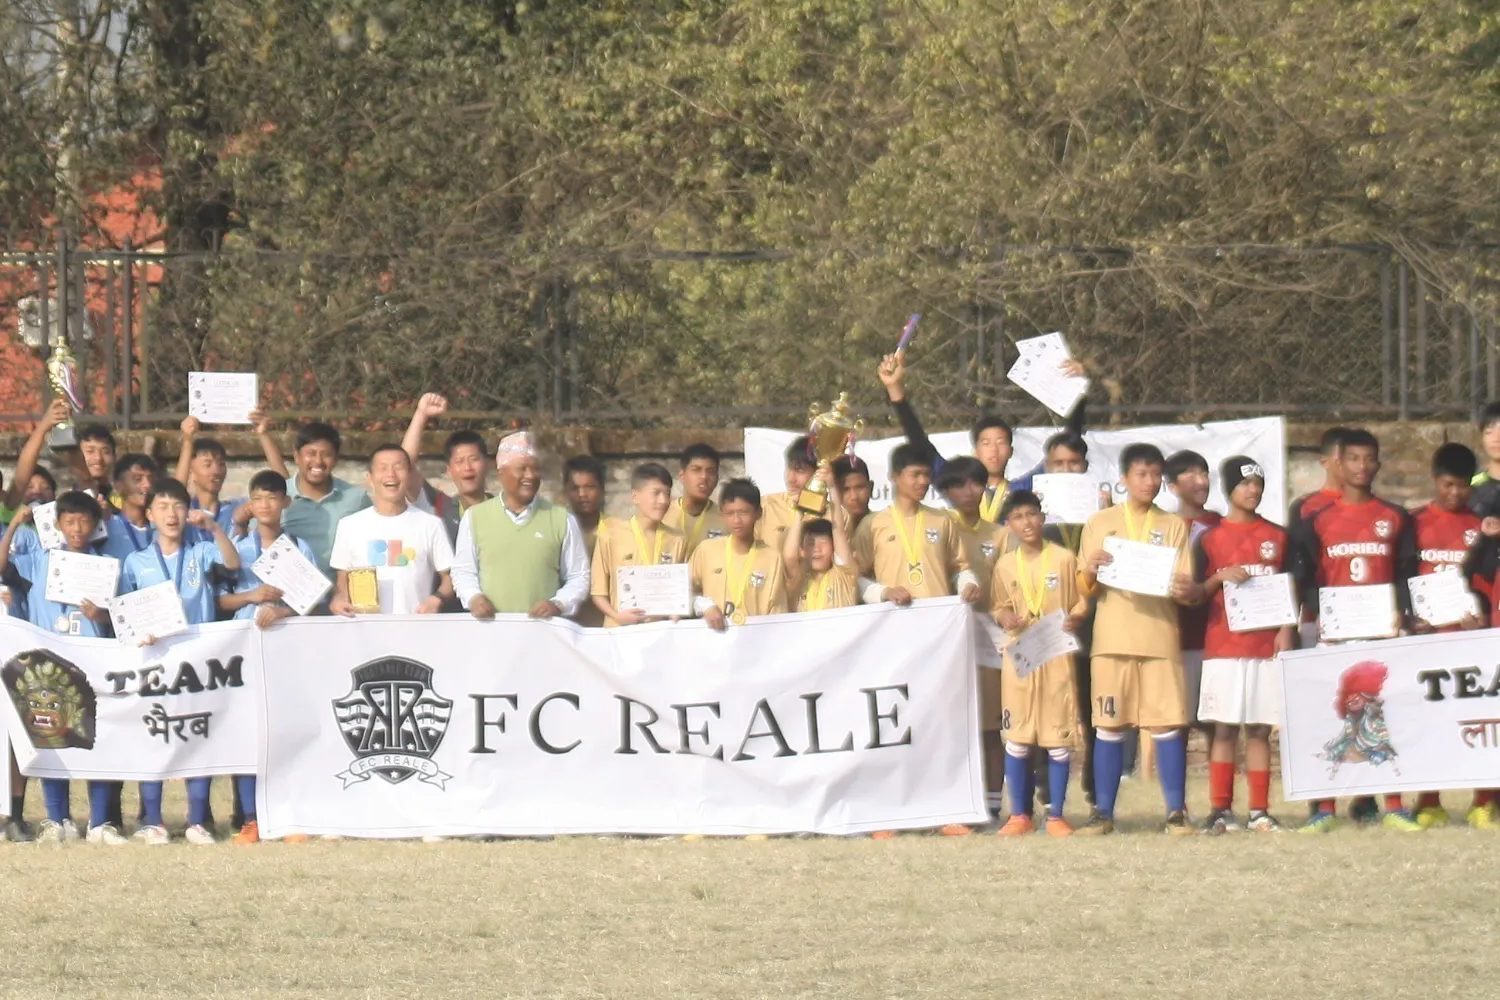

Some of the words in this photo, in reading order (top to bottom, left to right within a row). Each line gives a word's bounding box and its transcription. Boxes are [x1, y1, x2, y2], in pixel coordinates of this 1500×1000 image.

[1327, 542, 1388, 558] HORIBA
[1350, 558, 1366, 582] 9
[104, 655, 245, 696] TEAM
[468, 691, 582, 754] FC
[613, 683, 912, 762] REALE
[383, 755, 429, 771] REALE
